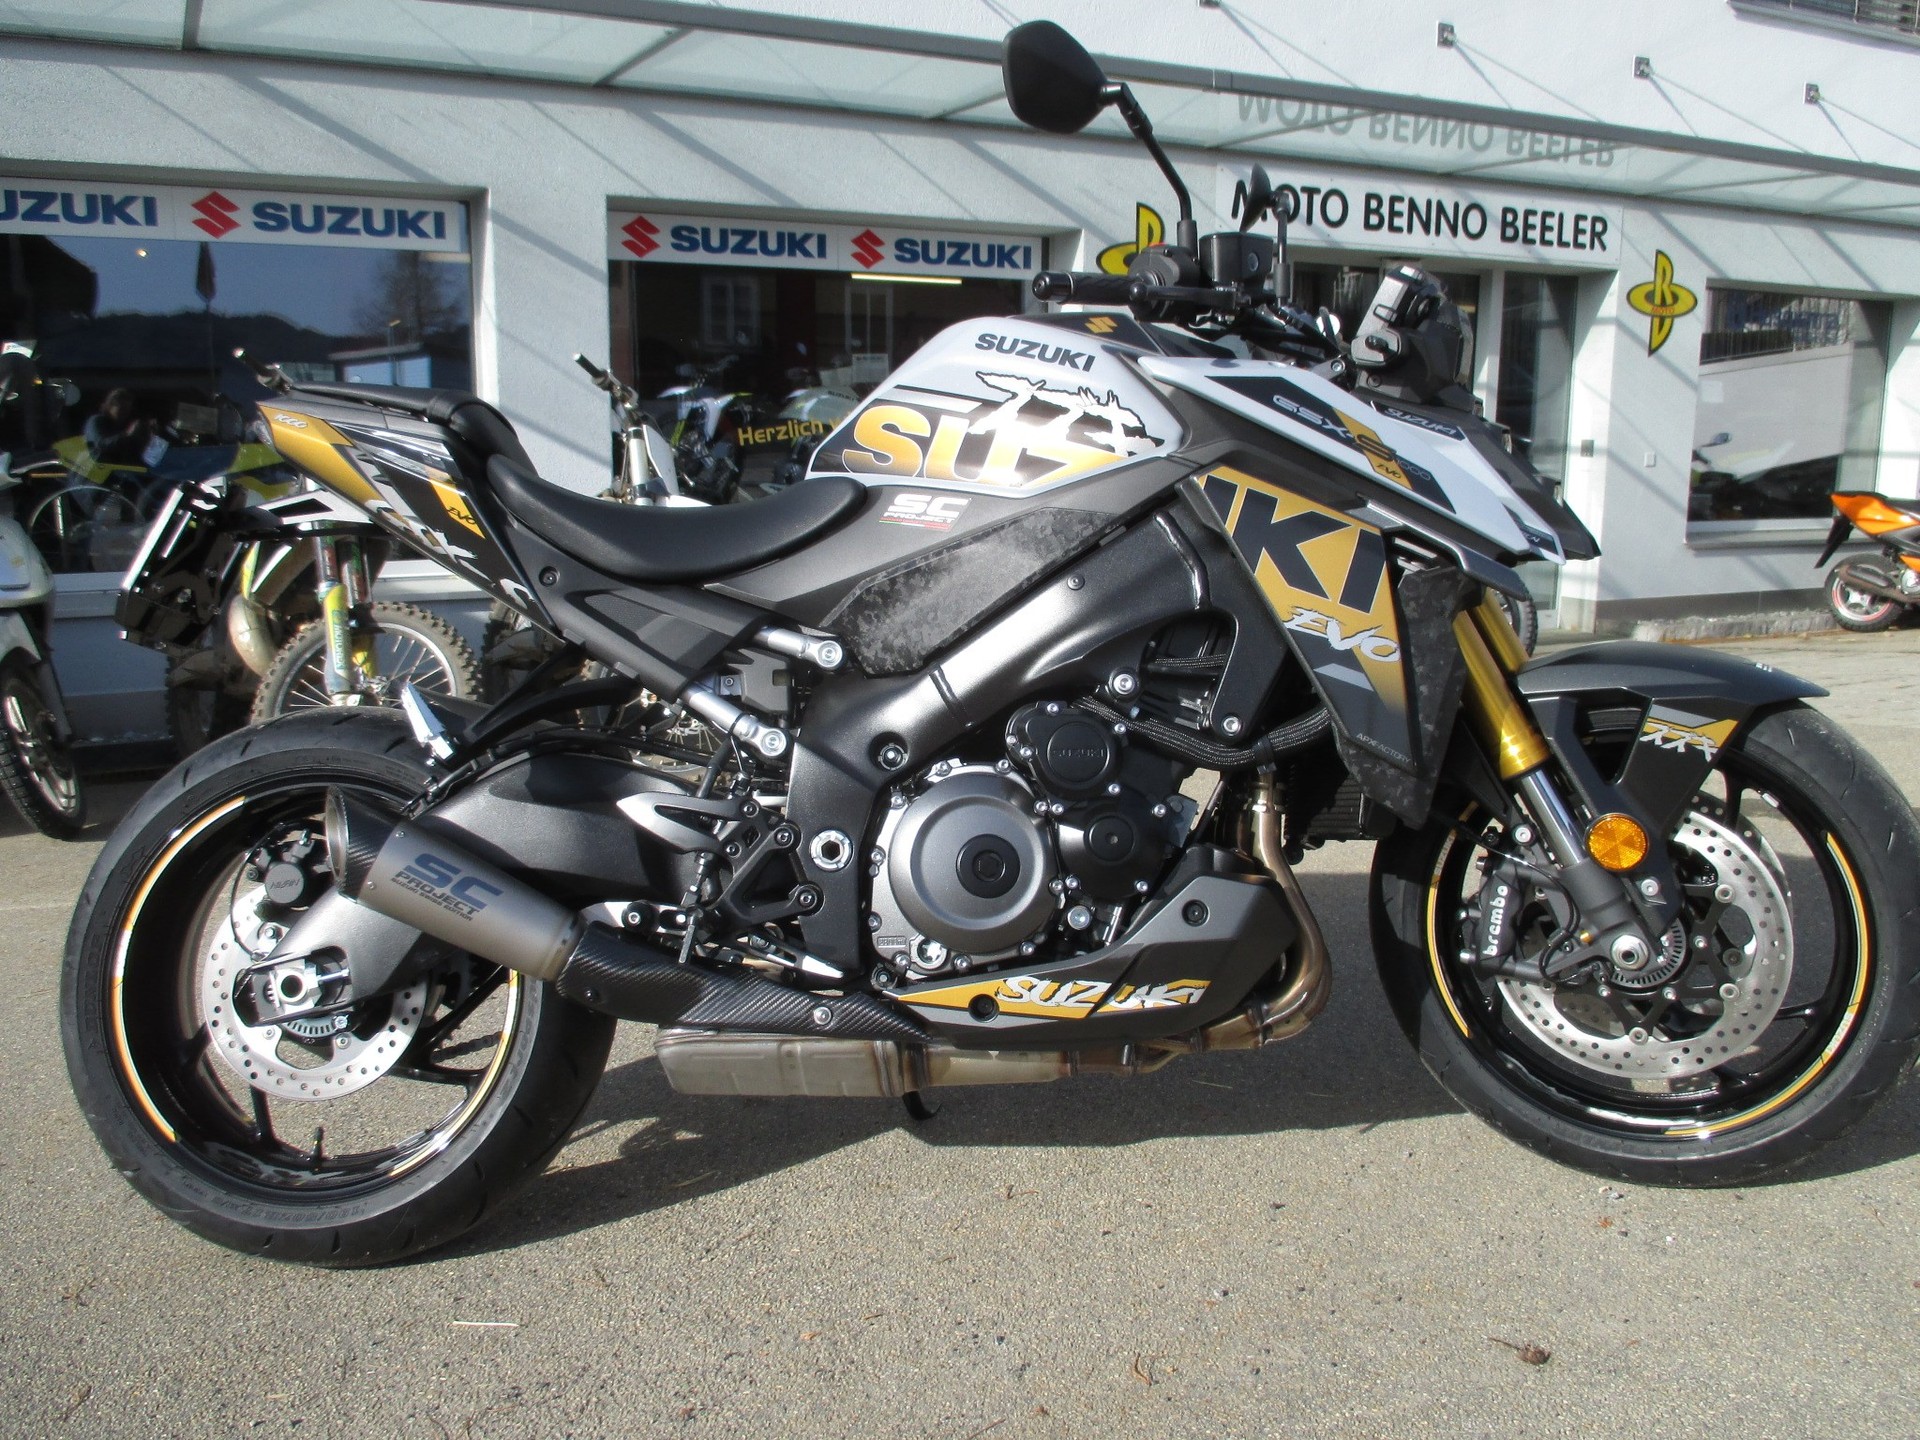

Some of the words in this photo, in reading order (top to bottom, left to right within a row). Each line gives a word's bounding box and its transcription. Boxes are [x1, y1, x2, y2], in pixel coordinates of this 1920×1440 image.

[252, 202, 447, 240] SUZUKI
[1363, 192, 1488, 242] BENNO
[1500, 207, 1608, 252] BEELER
[670, 224, 828, 260] SUZUKI
[894, 237, 1033, 271] SUZUKI
[974, 333, 1096, 372] SUZUKI
[737, 419, 824, 447] Herzlich
[447, 506, 477, 525] EVO
[887, 493, 969, 518] SC
[1283, 605, 1402, 663] EVO
[395, 870, 481, 915] PROJECT
[402, 853, 504, 910] SC
[1482, 885, 1508, 957] brembo
[995, 975, 1207, 1009] SUZUKI
